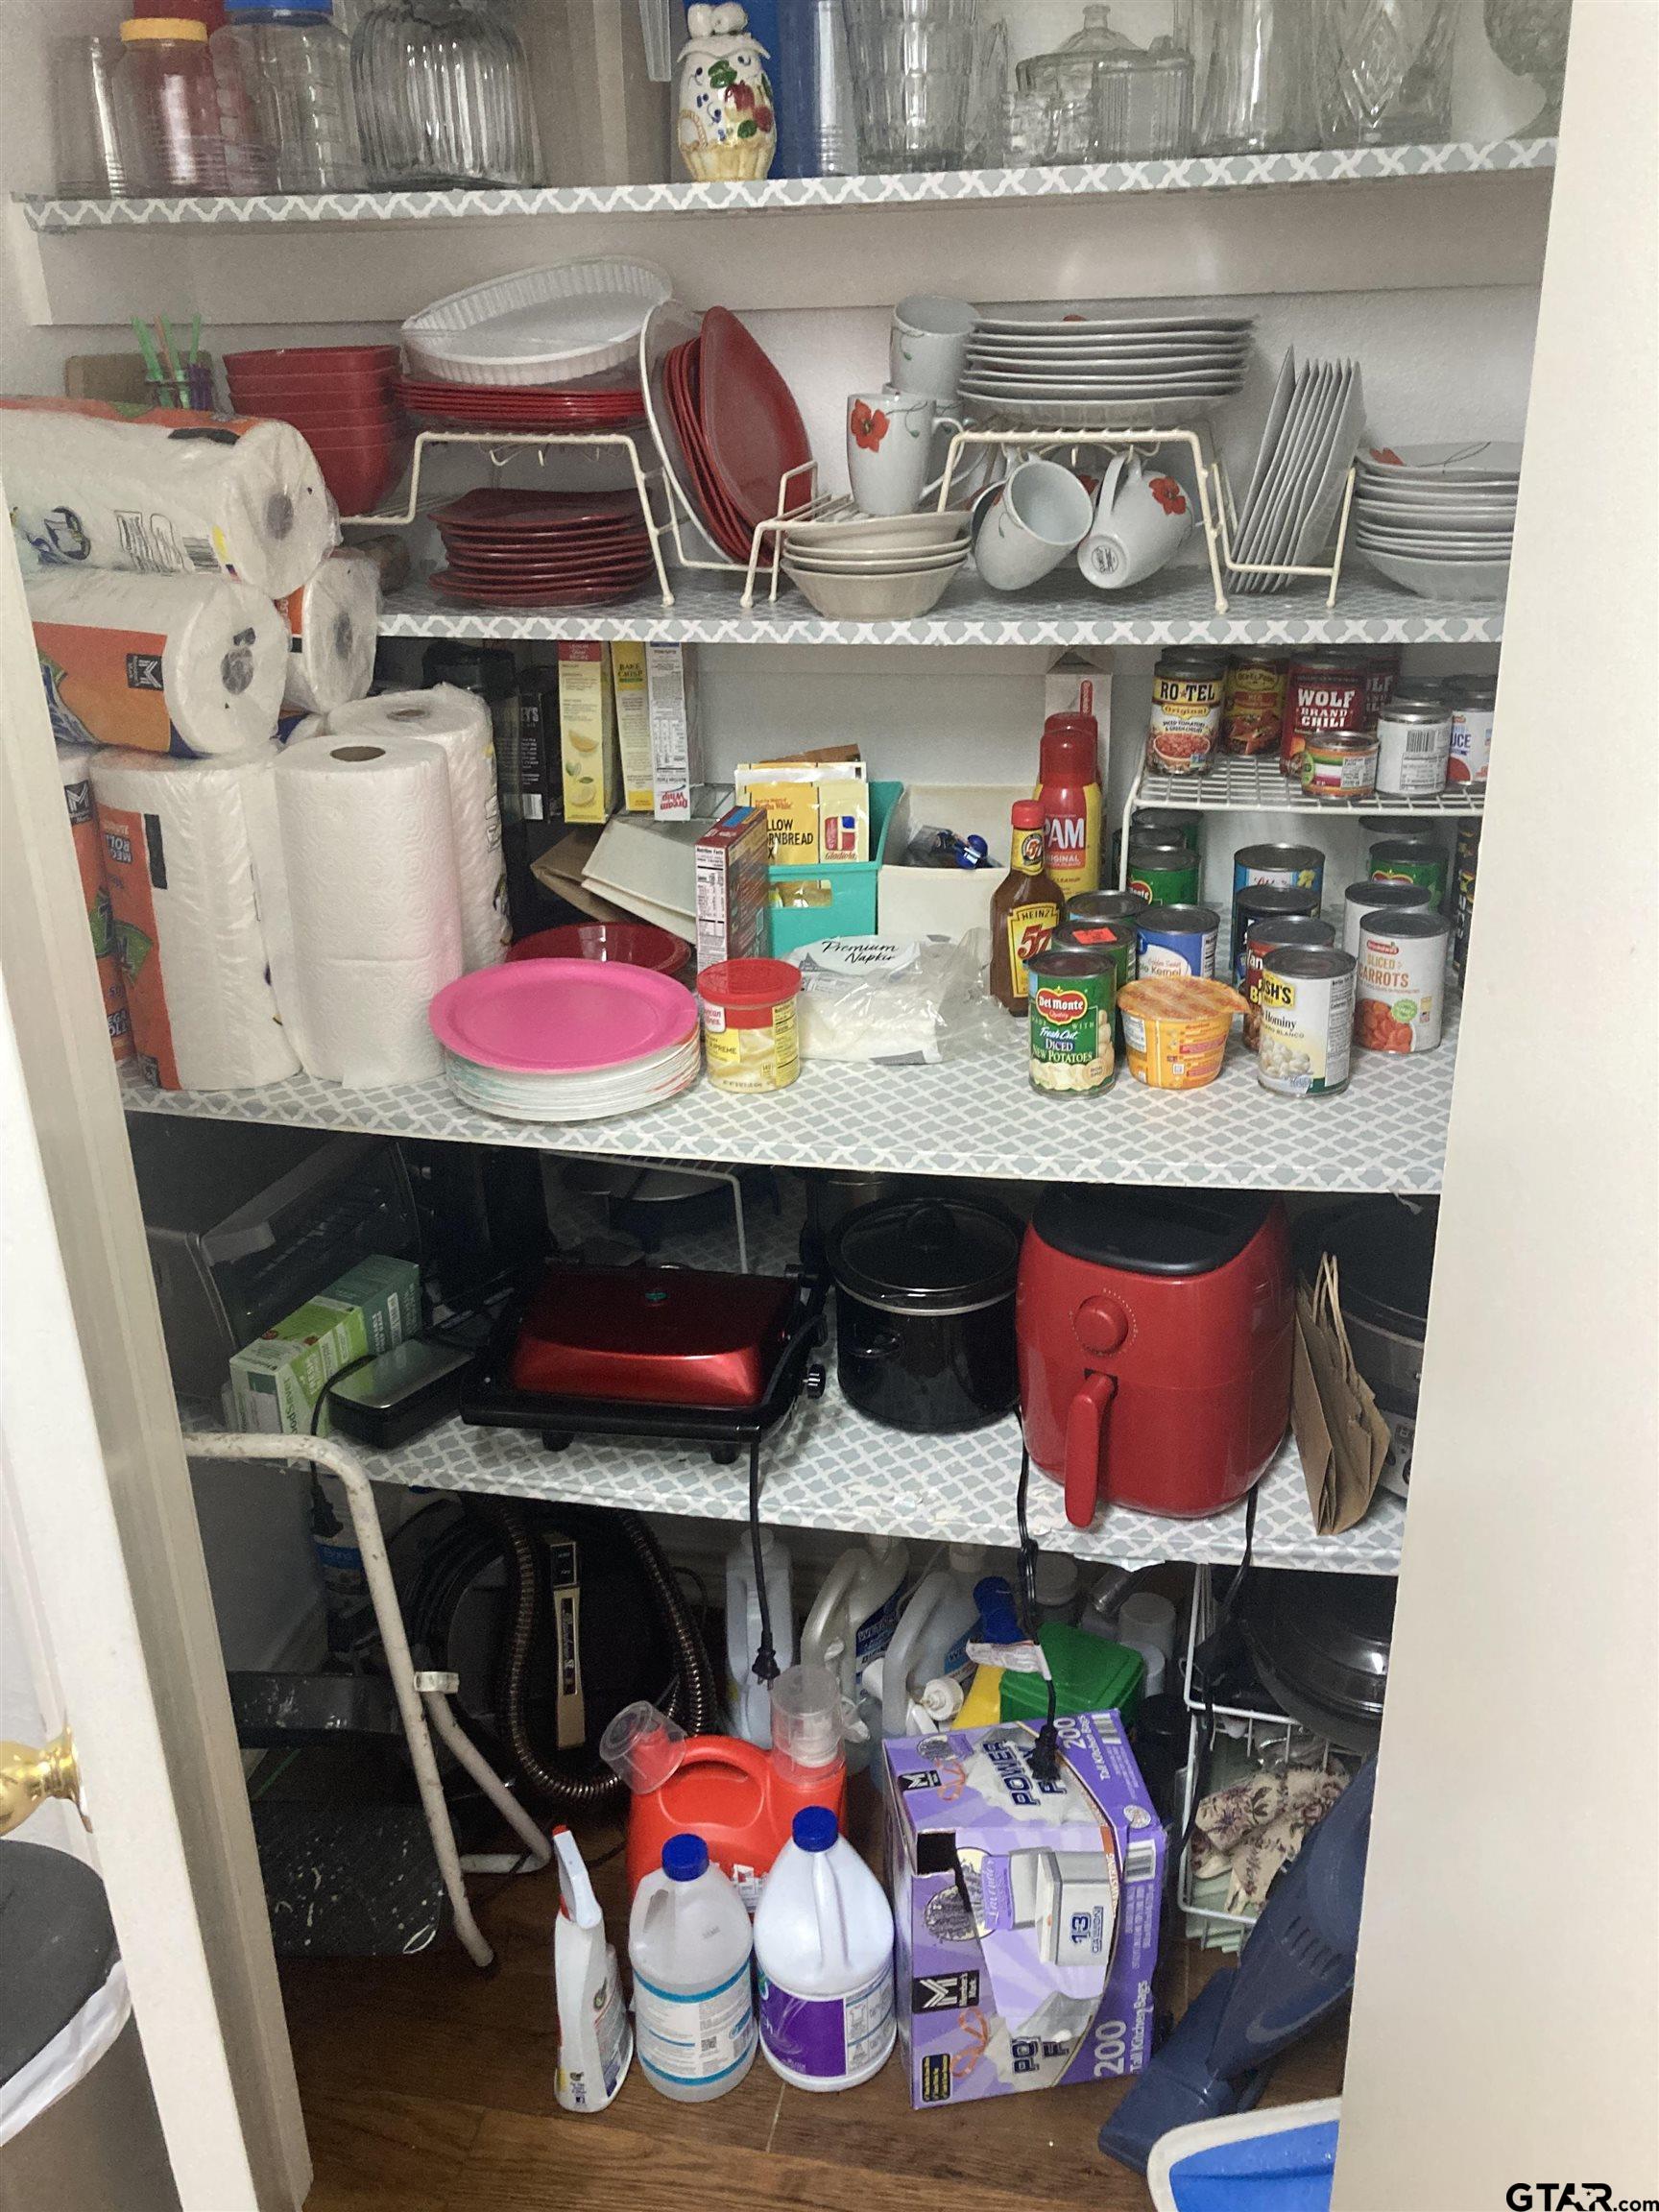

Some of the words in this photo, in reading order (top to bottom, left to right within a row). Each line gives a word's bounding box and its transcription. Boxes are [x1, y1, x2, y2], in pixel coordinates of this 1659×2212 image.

[1297, 688, 1356, 708] WOLF
[1301, 708, 1348, 716] BRAND
[1301, 716, 1346, 727] CHILI
[1451, 733, 1471, 749] UCE
[768, 832, 814, 846] RNBREAD
[1051, 854, 1080, 863] IGINAL
[1022, 907, 1051, 920] HEINZ
[822, 940, 900, 953] Premium
[1017, 925, 1053, 960] 57
[1367, 953, 1396, 969] SLICED
[1358, 966, 1409, 988] CARROTS
[1262, 979, 1292, 1004] USH'S
[1039, 996, 1052, 1009] Del
[1052, 998, 1084, 1011] Monte
[108, 1009, 128, 1024] EGA
[1049, 1010, 1070, 1020] Quality
[1264, 1010, 1297, 1031] Hominy
[108, 1020, 129, 1037] OLL
[1040, 1025, 1060, 1038] Fresh
[1059, 1029, 1078, 1040] Cut
[1071, 1022, 1094, 1030] WITH
[1046, 1038, 1073, 1052] DICED
[1047, 1049, 1093, 1064] POTATOES
[1077, 1714, 1093, 1735] Bags
[1053, 1717, 1087, 1750] 200
[982, 1739, 1041, 1806] POWER
[1097, 1763, 1111, 1781] Tall
[1070, 1911, 1091, 1945] 13
[1092, 1905, 1104, 1954] GALLON
[1093, 2019, 1127, 2078] 200
[1130, 2050, 1144, 2074] Tall
